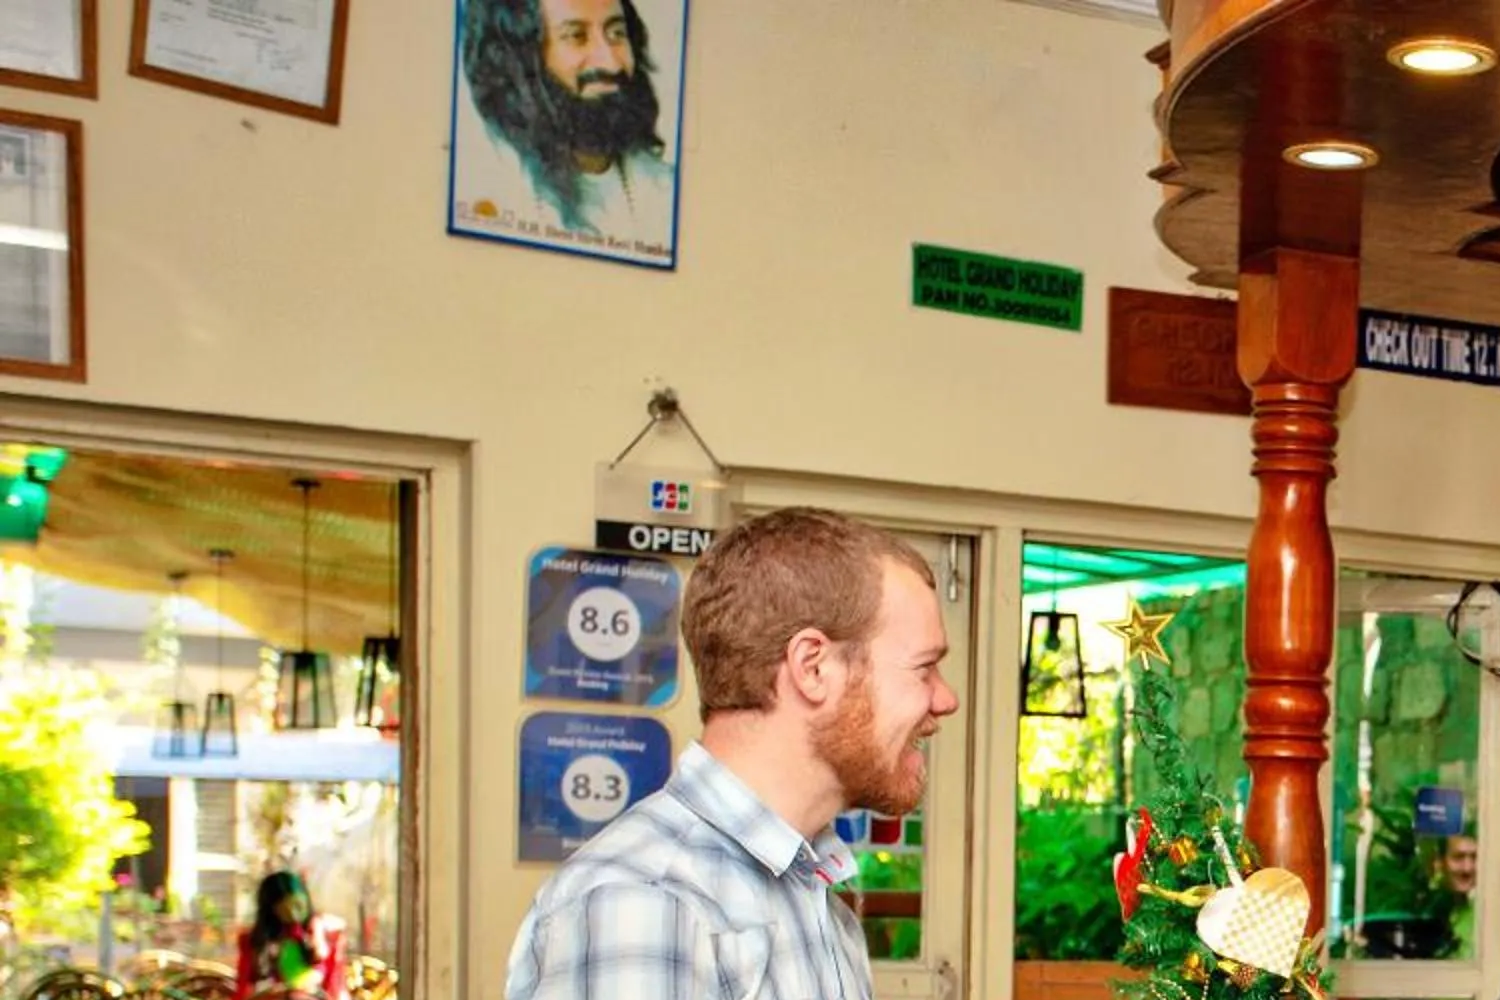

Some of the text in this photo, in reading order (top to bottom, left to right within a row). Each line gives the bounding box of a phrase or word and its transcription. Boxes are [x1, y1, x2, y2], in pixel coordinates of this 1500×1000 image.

[918, 252, 1079, 301] HOTEL GRAND HOLIDAY
[1365, 317, 1410, 367] CHECK
[1411, 324, 1437, 371] OUT
[1440, 327, 1471, 375] TIME
[628, 525, 711, 554] OPEN
[541, 557, 577, 573] Hotel
[580, 561, 619, 576] Grand
[580, 606, 630, 636] 8.6
[571, 773, 622, 801] 8.3
